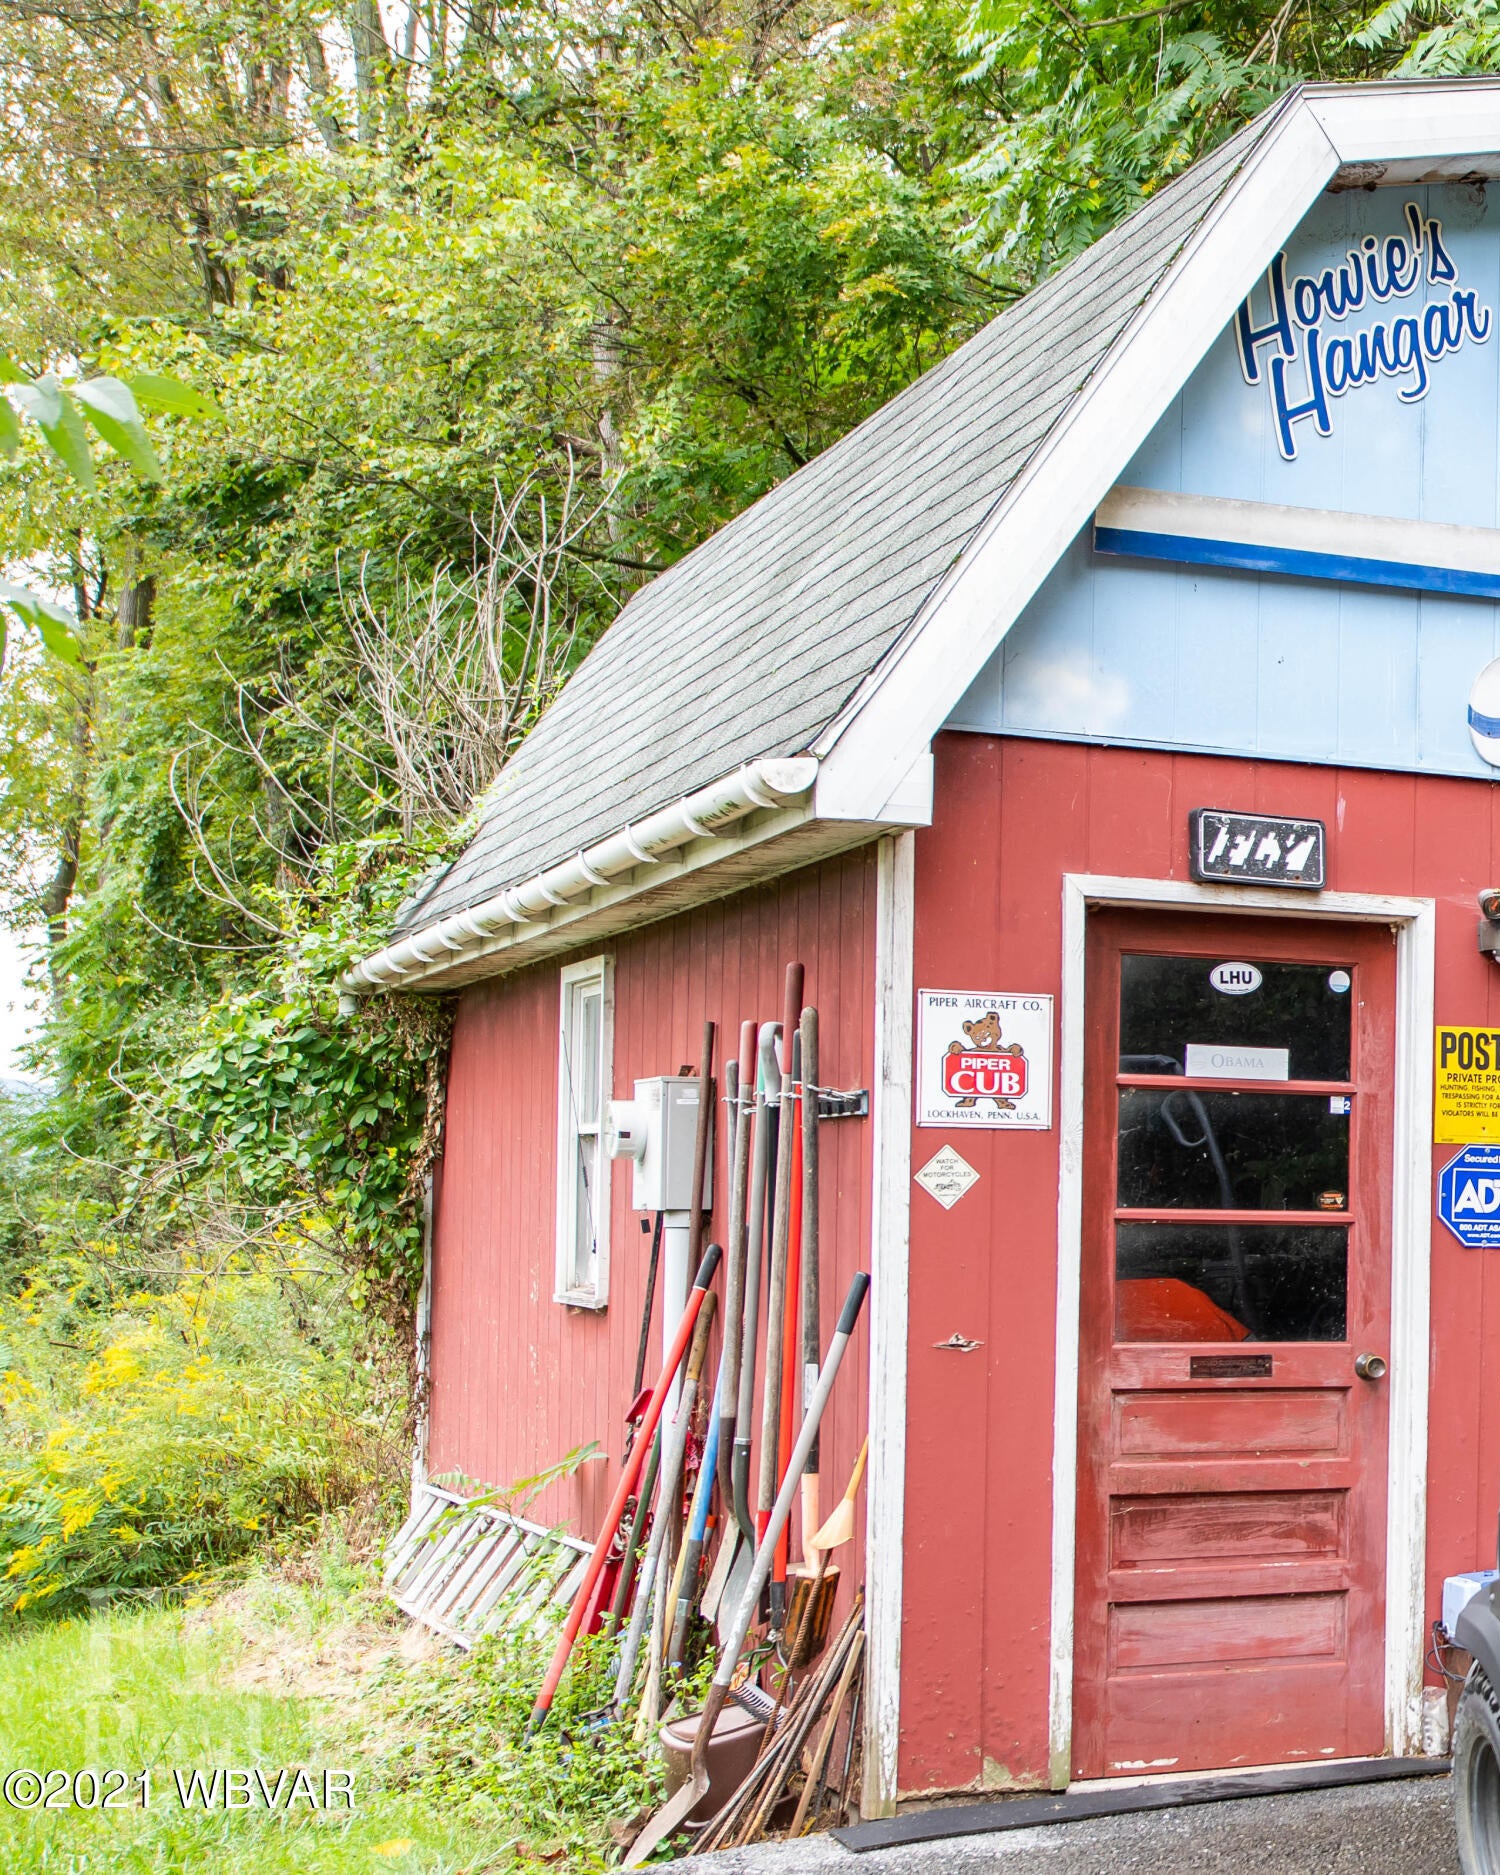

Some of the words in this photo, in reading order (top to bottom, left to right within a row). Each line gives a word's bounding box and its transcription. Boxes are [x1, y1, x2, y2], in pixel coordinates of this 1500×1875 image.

[1235, 203, 1457, 382] Howie's
[1269, 290, 1491, 458] Hangar
[1220, 970, 1252, 985] LHU
[928, 996, 958, 1007] PIPER
[964, 998, 1017, 1010] AIRCRAFT
[1022, 1000, 1043, 1011] CO.
[960, 1057, 1011, 1071] PIPER
[950, 1070, 1020, 1095] CUB
[1447, 1072, 1482, 1084] PRIVATE
[927, 1109, 983, 1120] LOCKHAVEN,
[987, 1111, 1013, 1120] PENN.
[1016, 1112, 1041, 1121] U.S.A.
[1464, 1154, 1498, 1164] Secured
